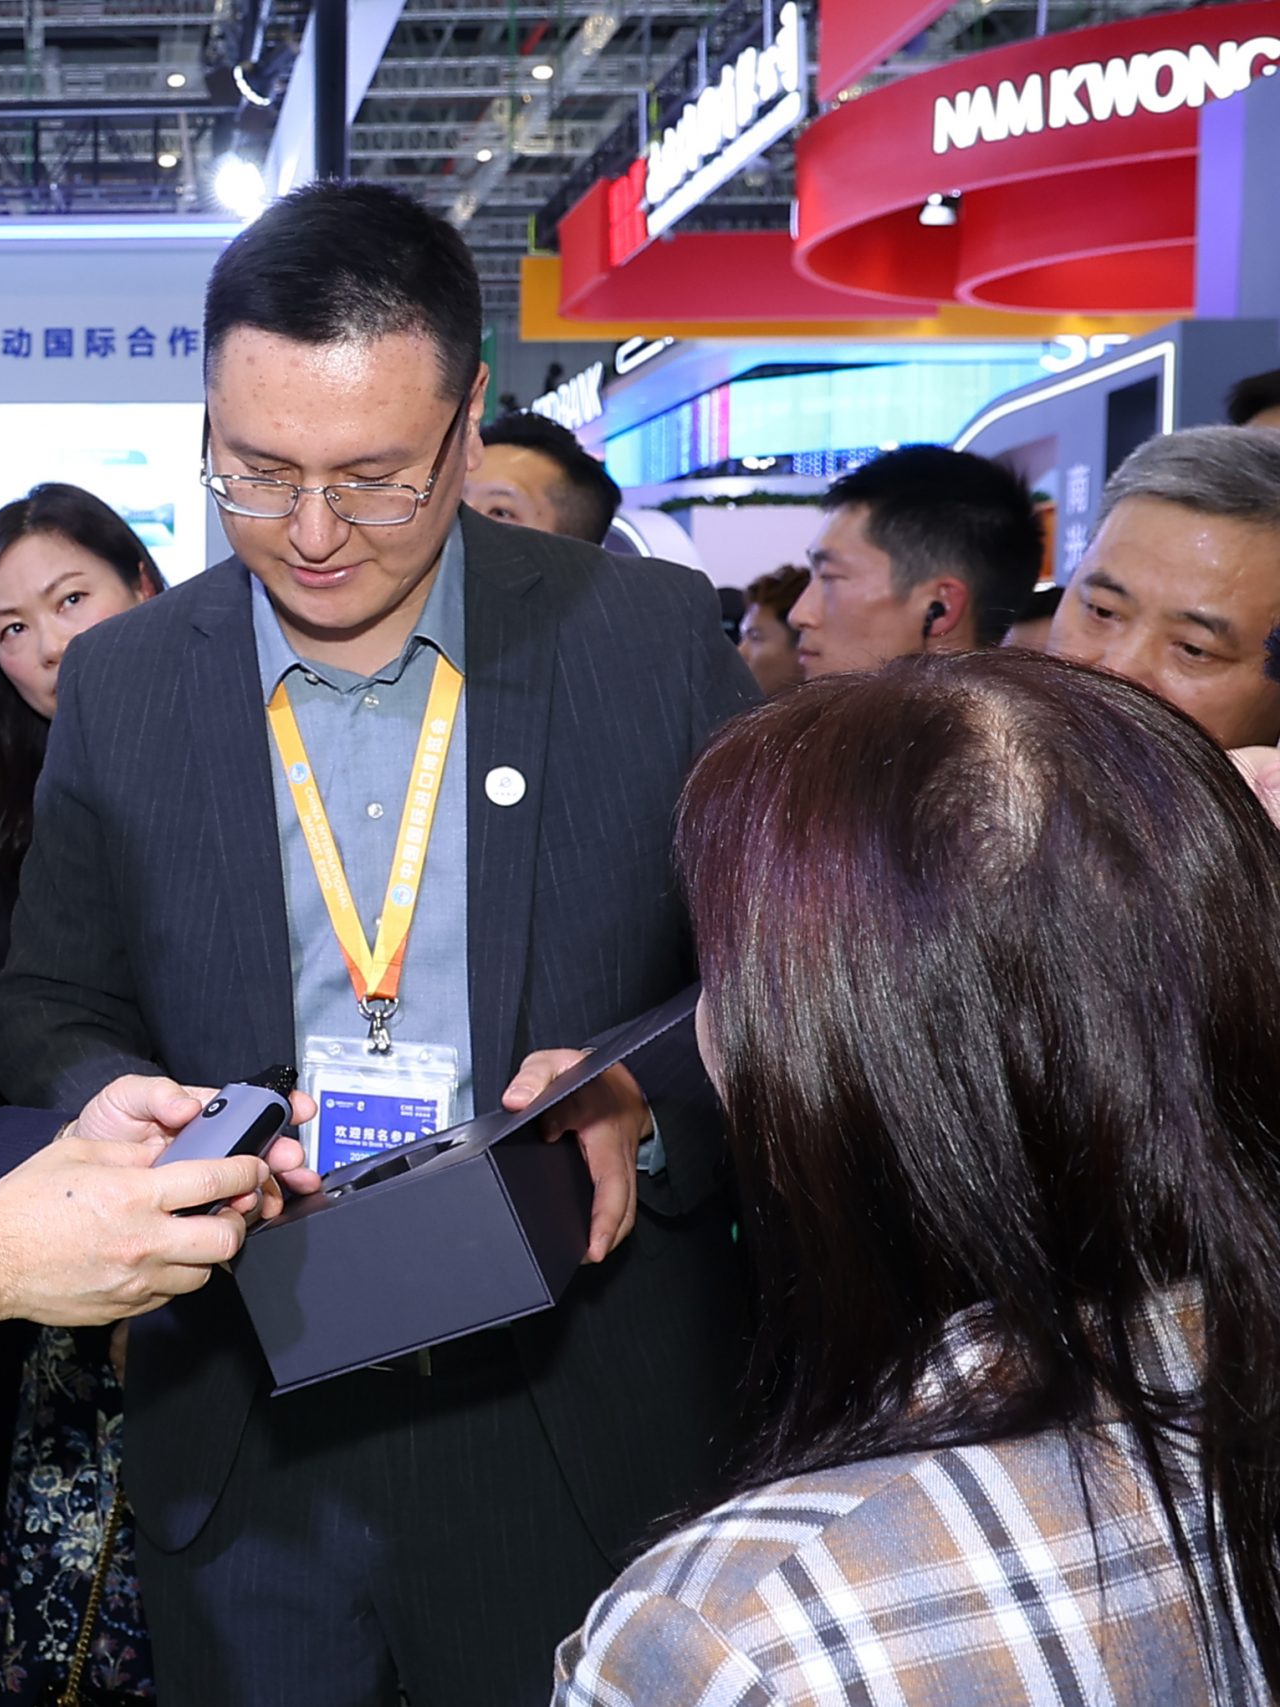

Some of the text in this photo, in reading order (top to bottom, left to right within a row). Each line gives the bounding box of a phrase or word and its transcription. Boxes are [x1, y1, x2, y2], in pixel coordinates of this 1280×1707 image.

[932, 73, 1044, 155] NAM
[399, 717, 449, 881] 中国国际进口博览会
[303, 815, 333, 890] IMPORT EXPO
[304, 786, 350, 913] CHINA INTERNATIONAL
[334, 1125, 417, 1143] 欢迎报名参展
